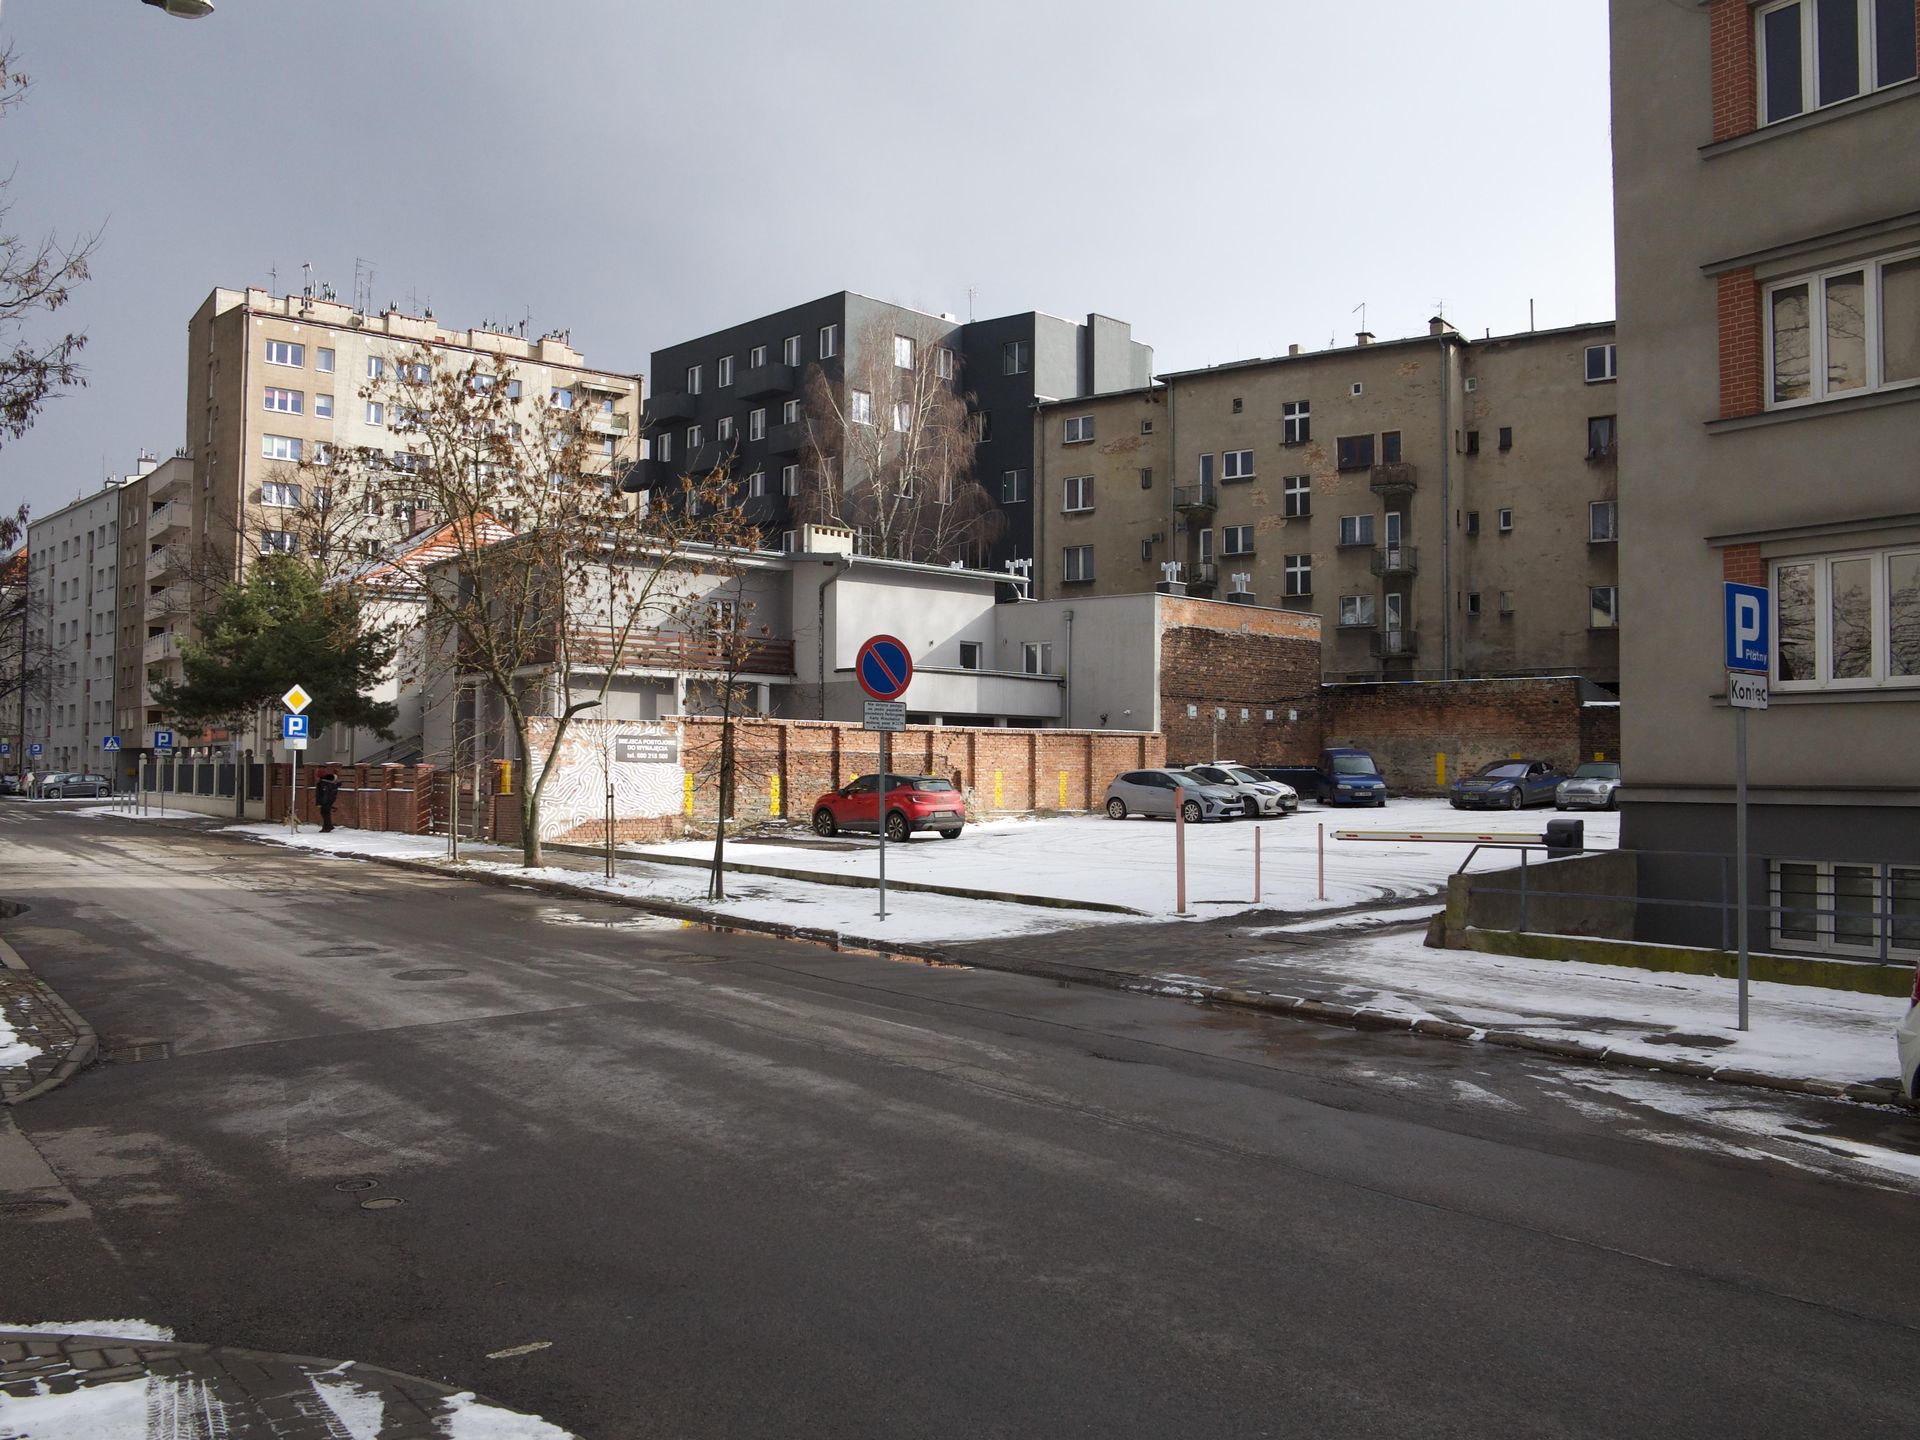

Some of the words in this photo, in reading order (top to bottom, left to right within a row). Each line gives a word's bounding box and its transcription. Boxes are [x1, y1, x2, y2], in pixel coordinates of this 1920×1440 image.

[1735, 593, 1760, 658] P
[1731, 680, 1766, 702] Koniec
[288, 717, 303, 735] P
[158, 733, 168, 745] P
